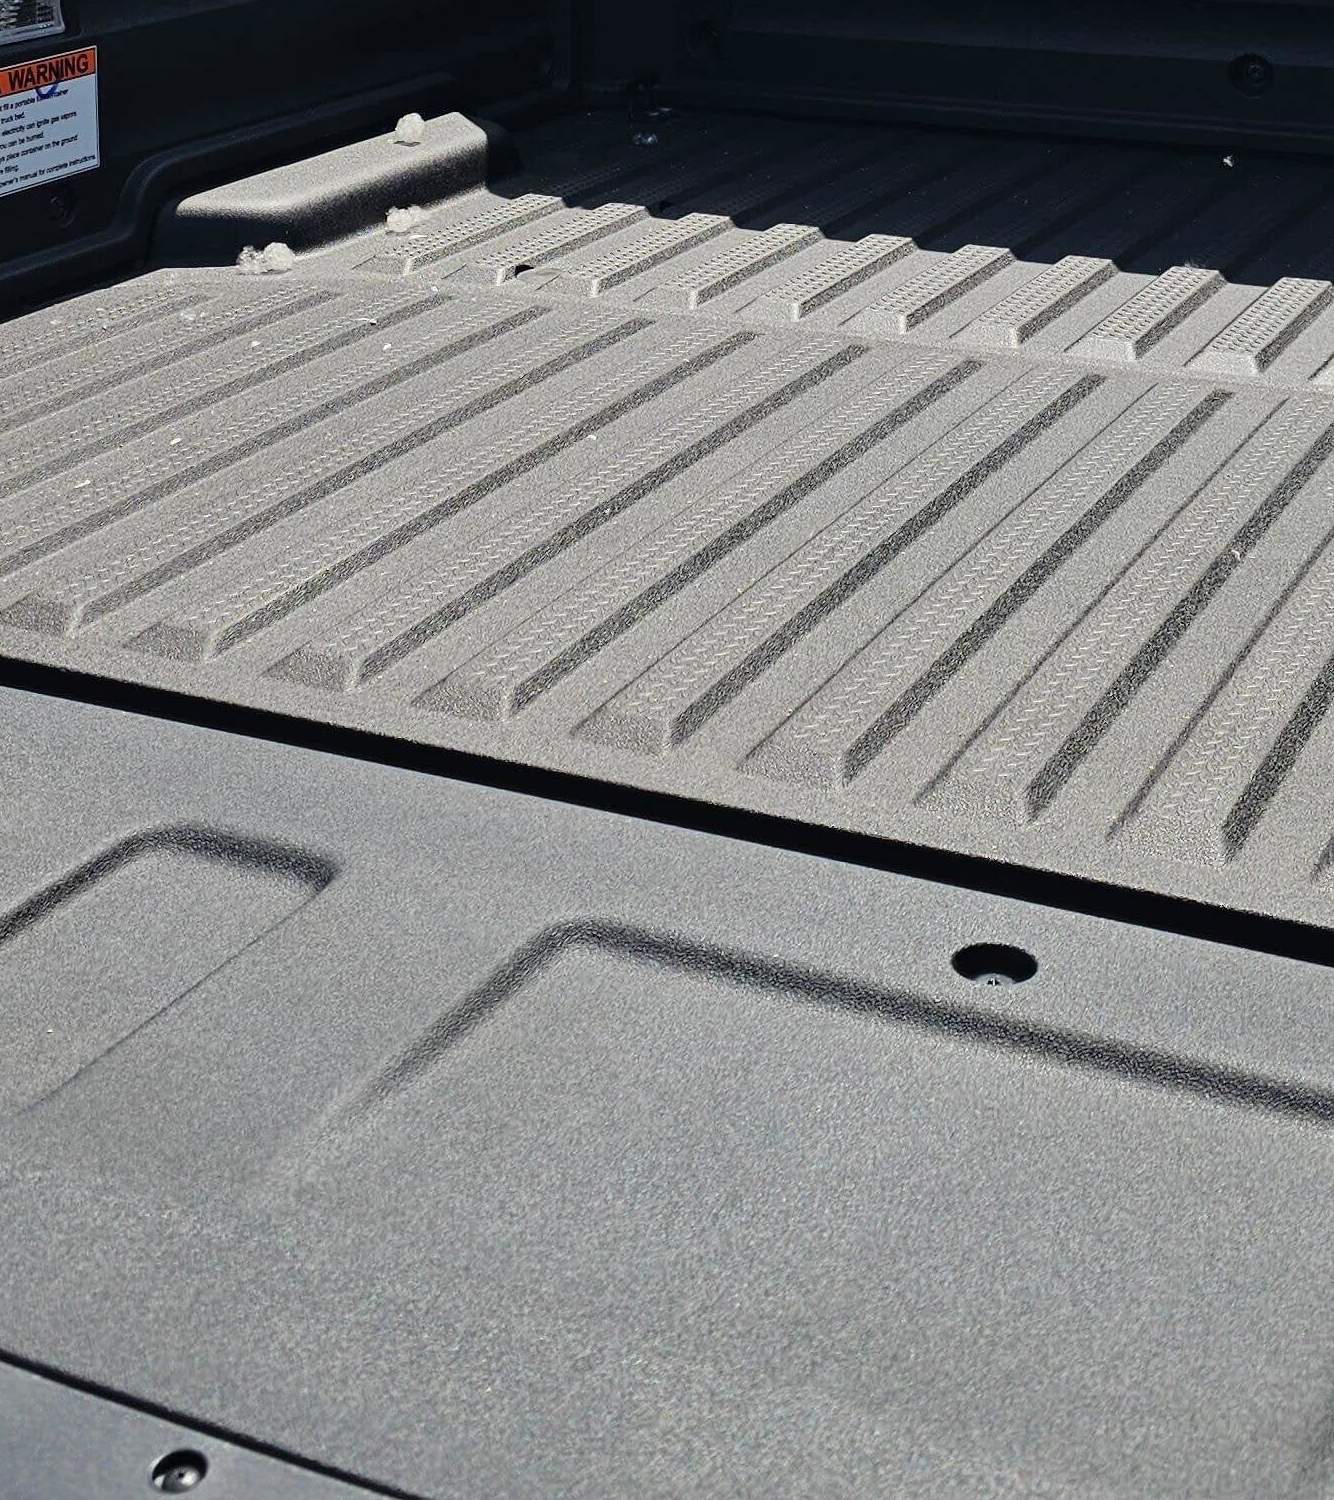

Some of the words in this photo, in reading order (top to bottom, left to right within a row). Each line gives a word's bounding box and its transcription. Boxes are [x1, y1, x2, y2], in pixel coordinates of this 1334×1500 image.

[8, 53, 89, 91] WARNING
[14, 97, 36, 110] portable
[1, 114, 14, 125] truck
[1, 124, 25, 137] electricity
[26, 122, 36, 130] can
[36, 118, 50, 129] ignite
[50, 116, 59, 125] gas
[60, 110, 77, 121] vapors
[6, 151, 20, 163] place
[20, 144, 44, 157] container
[44, 142, 52, 150] on
[52, 139, 60, 148] the
[60, 133, 79, 148] ground
[8, 139, 17, 148] can
[18, 137, 26, 146] be
[0, 177, 19, 189] owner's
[19, 171, 38, 182] manual
[38, 167, 46, 176] for
[46, 161, 69, 174] complete
